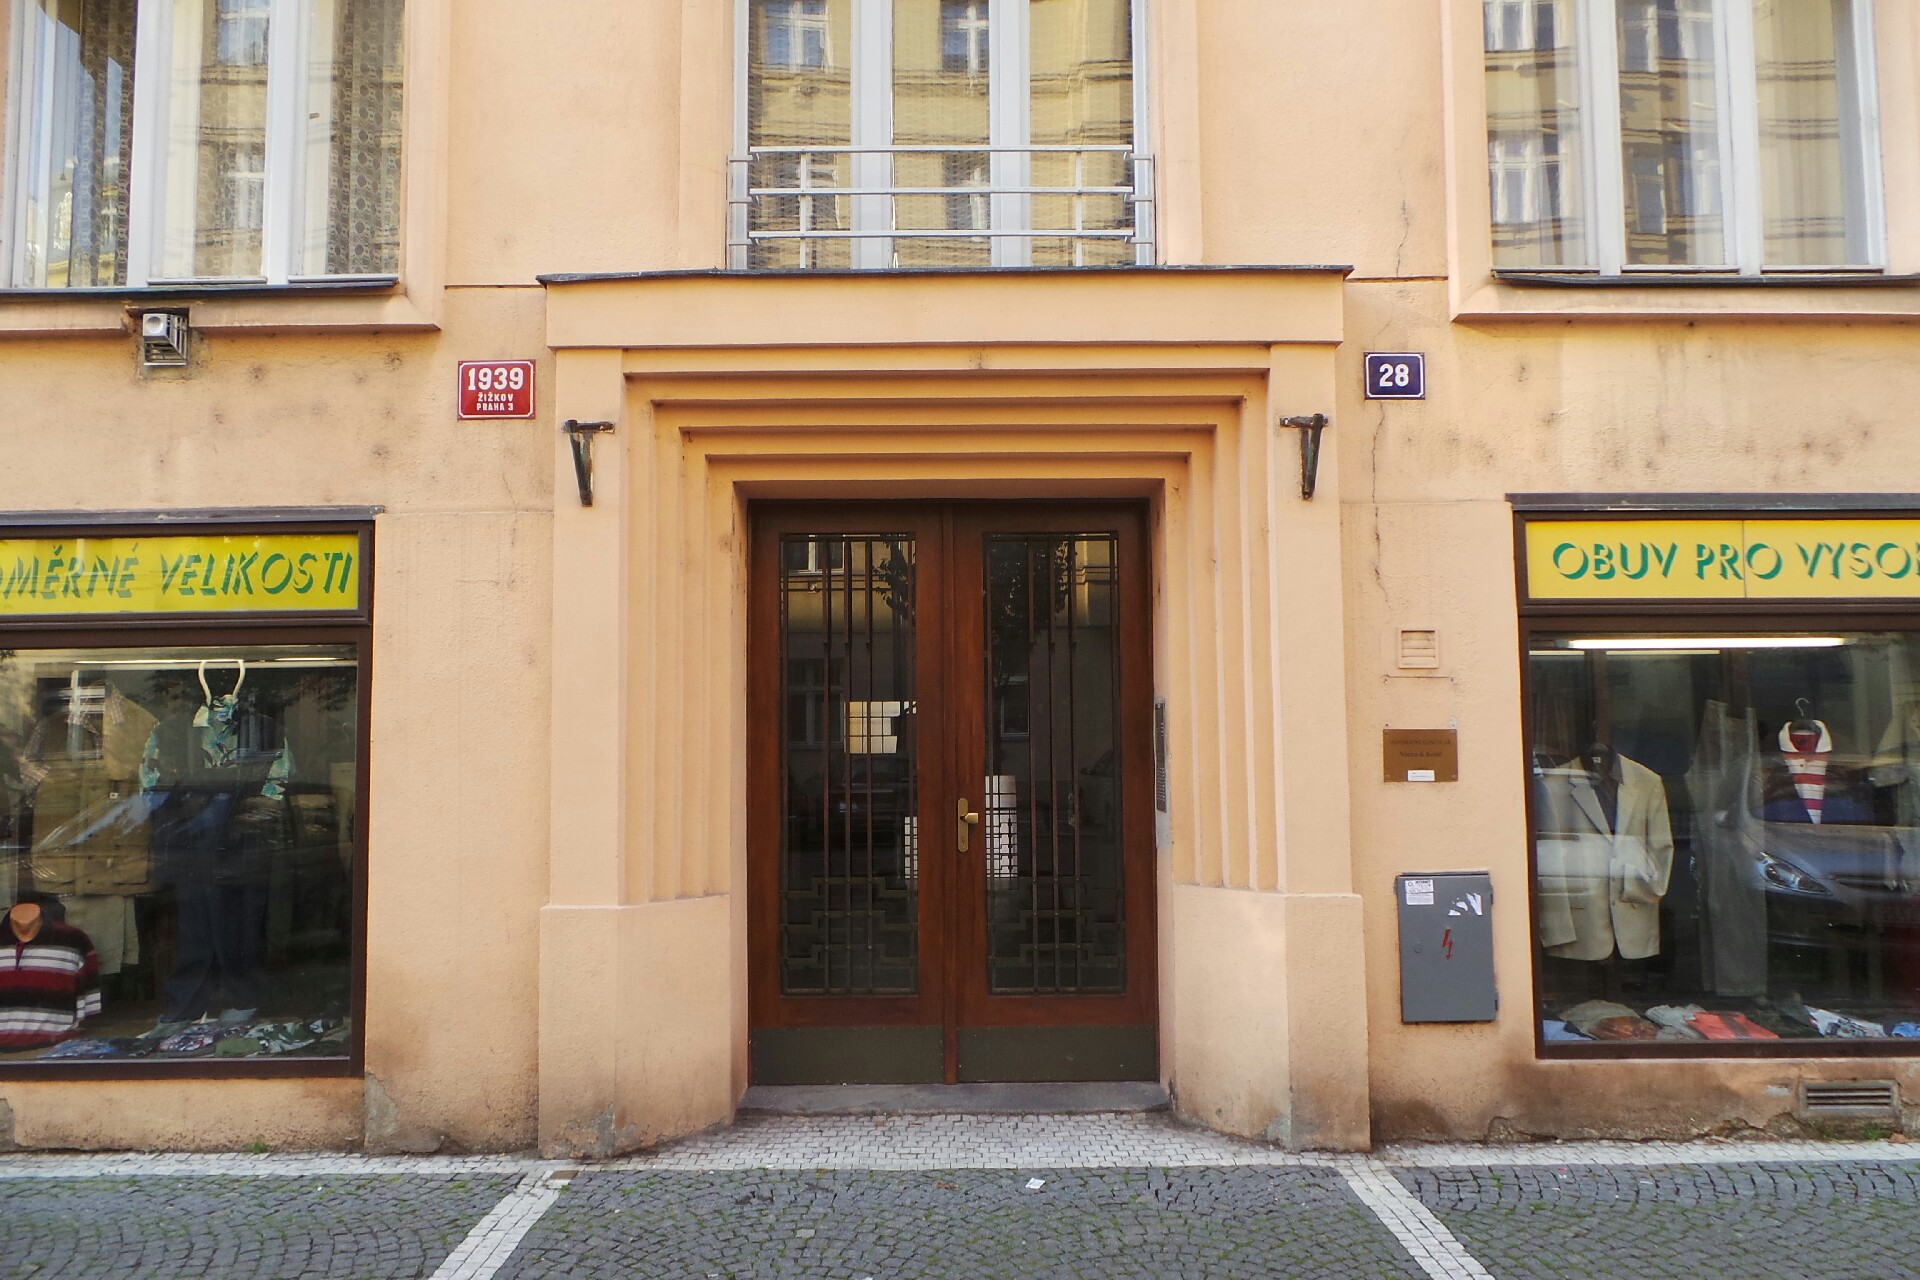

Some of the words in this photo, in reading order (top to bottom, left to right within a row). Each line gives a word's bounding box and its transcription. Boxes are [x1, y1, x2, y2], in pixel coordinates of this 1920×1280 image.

[468, 367, 524, 391] 1939
[1379, 363, 1409, 387] 28
[476, 402, 505, 411] PRAHA
[507, 402, 514, 411] 3
[477, 392, 514, 402] ŽIŽKOV
[0, 543, 139, 600] MĚRNÉ
[160, 551, 353, 597] VELIKOSTI
[1552, 542, 1679, 580] OBUV
[1696, 542, 1783, 580] PRO
[1796, 542, 1920, 580] VYSO
